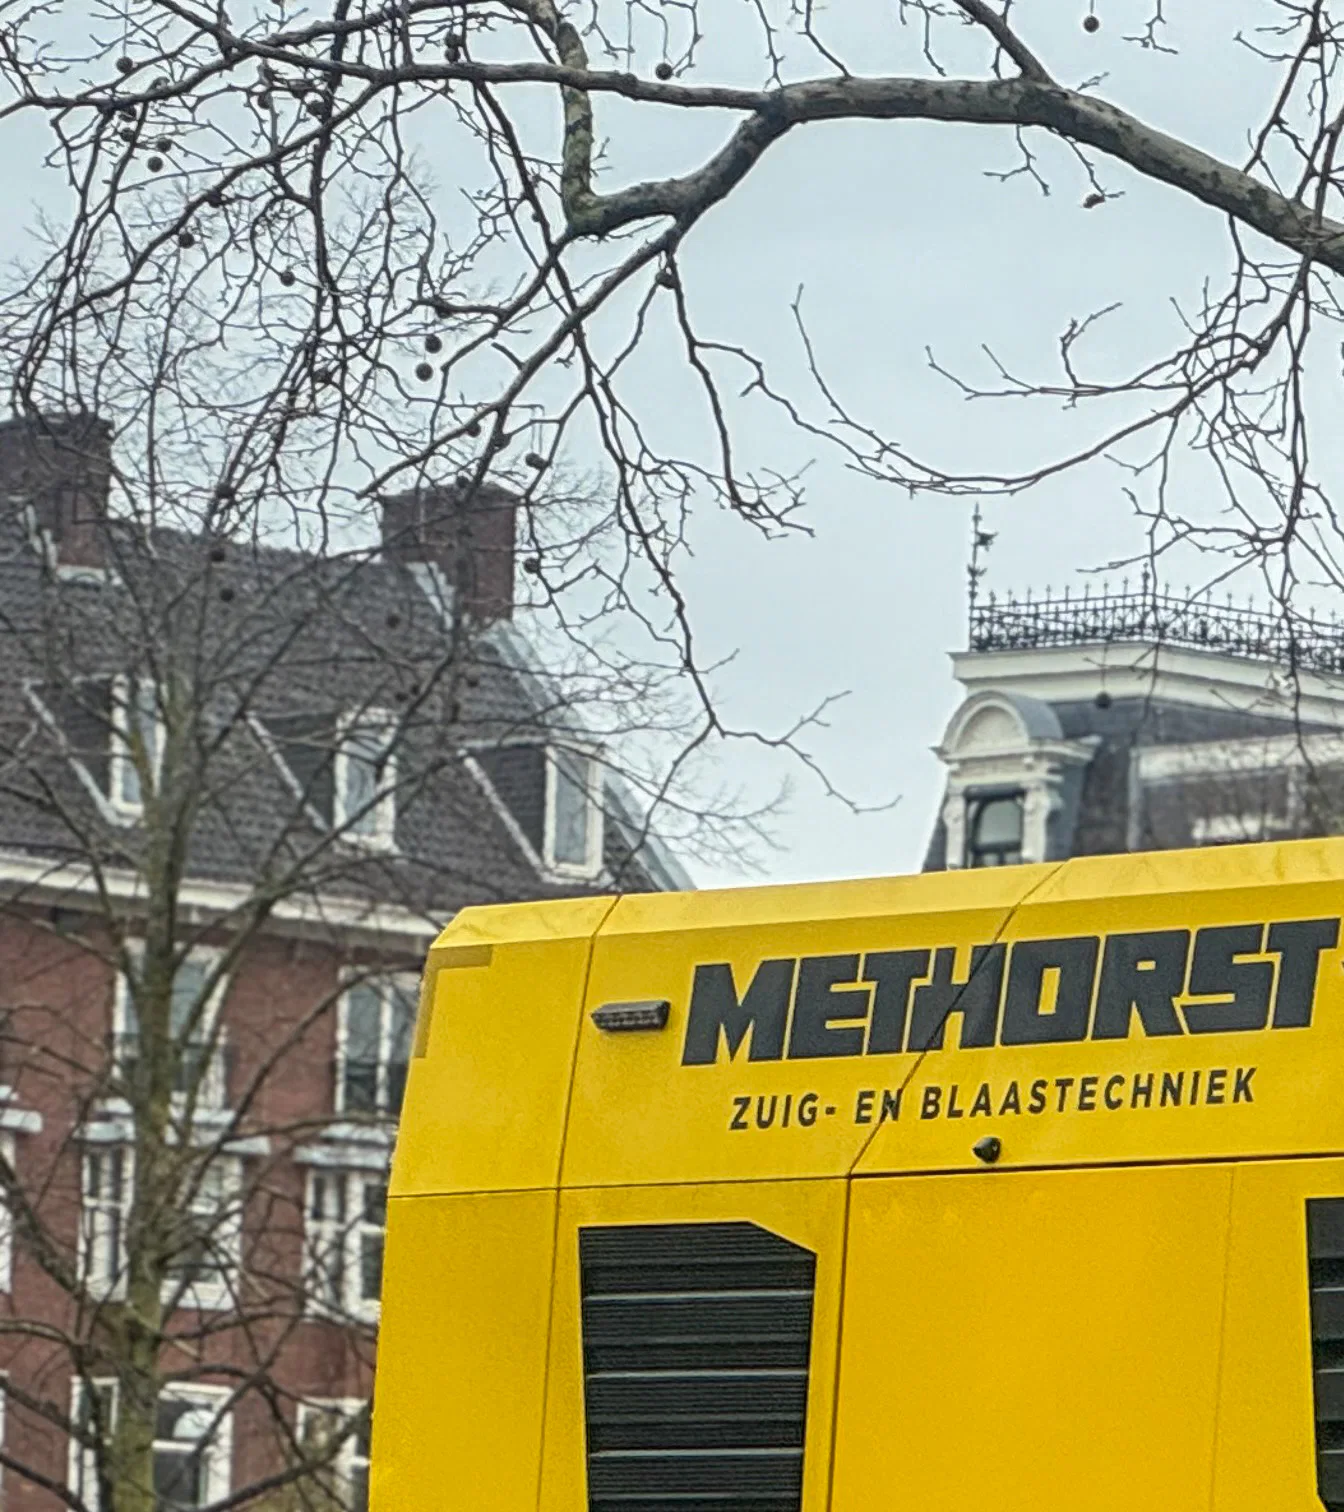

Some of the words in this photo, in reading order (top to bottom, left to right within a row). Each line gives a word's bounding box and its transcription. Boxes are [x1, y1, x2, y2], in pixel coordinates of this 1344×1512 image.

[682, 918, 1340, 1066] METHORST
[730, 1095, 836, 1131] ZUIG-
[855, 1089, 902, 1126] EN
[920, 1067, 1259, 1121] BLAASTECHNIEK
